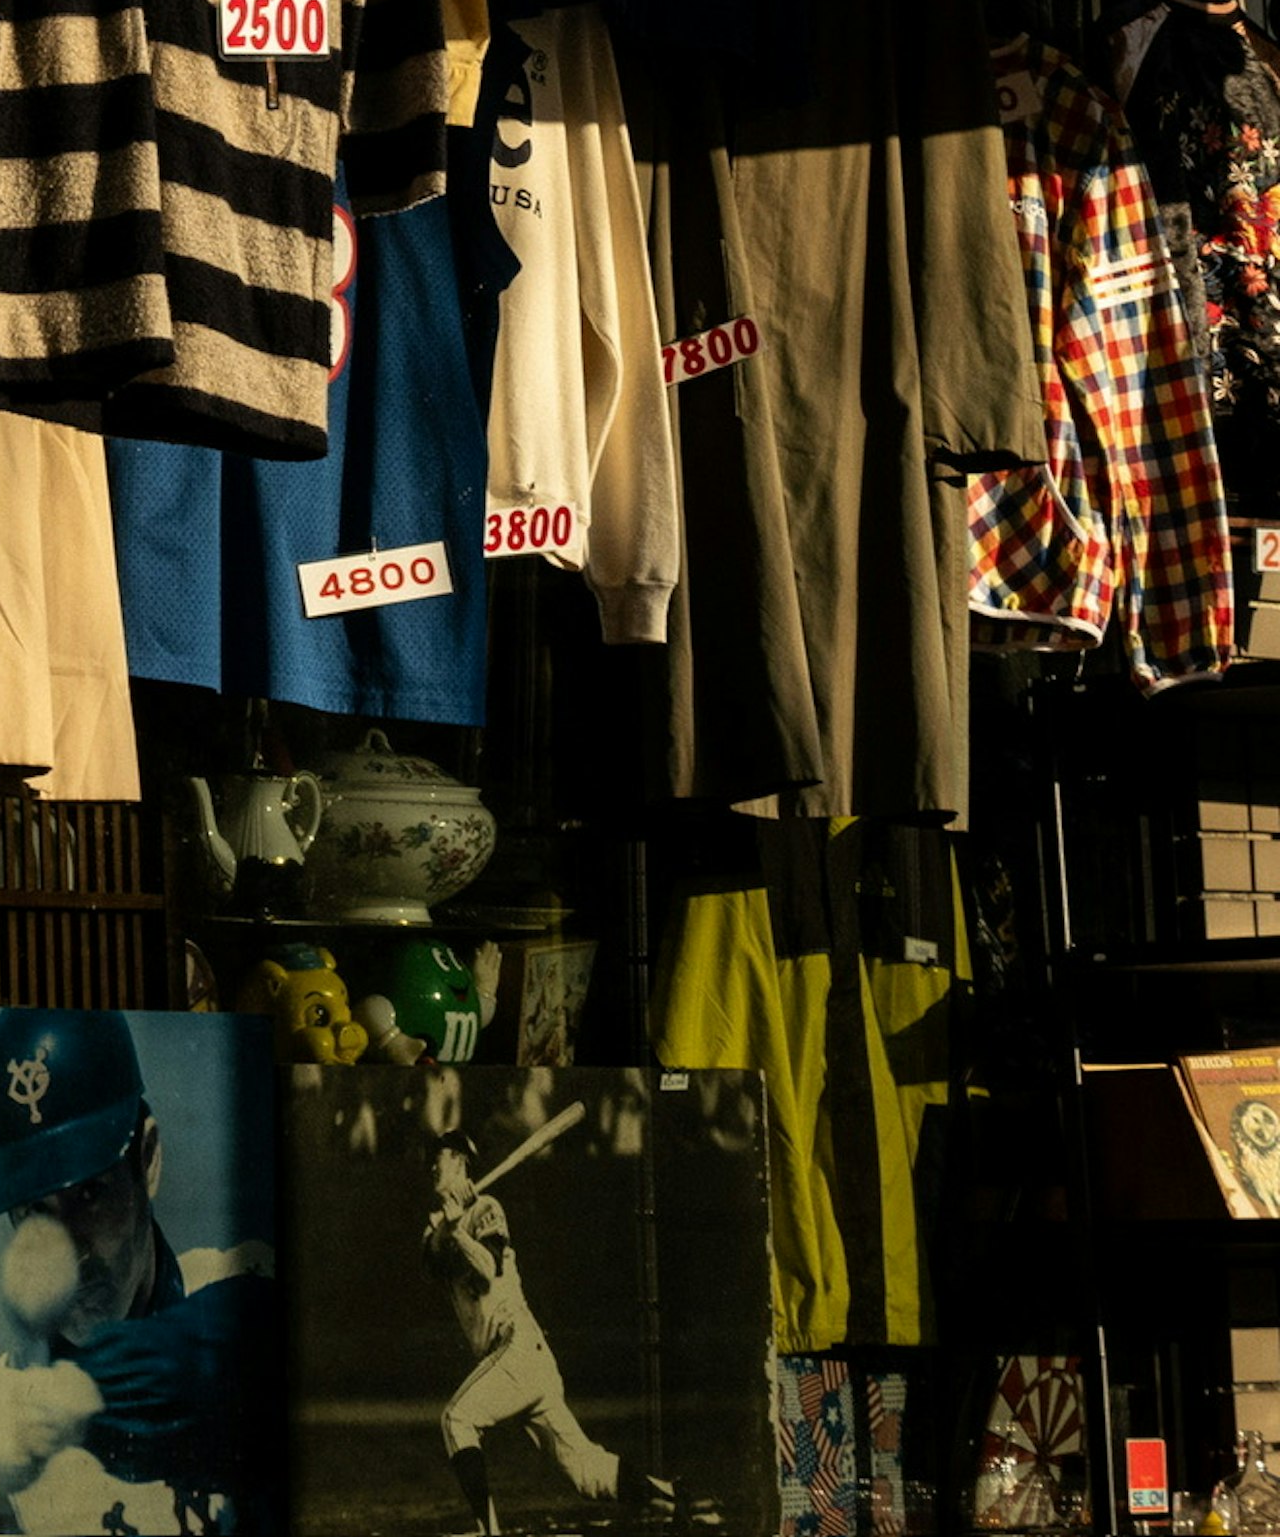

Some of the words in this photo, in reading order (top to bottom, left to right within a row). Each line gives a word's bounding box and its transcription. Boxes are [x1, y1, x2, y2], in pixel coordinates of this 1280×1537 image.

[491, 185, 543, 220] USA
[483, 505, 572, 552] 3800
[318, 557, 436, 600] 4800
